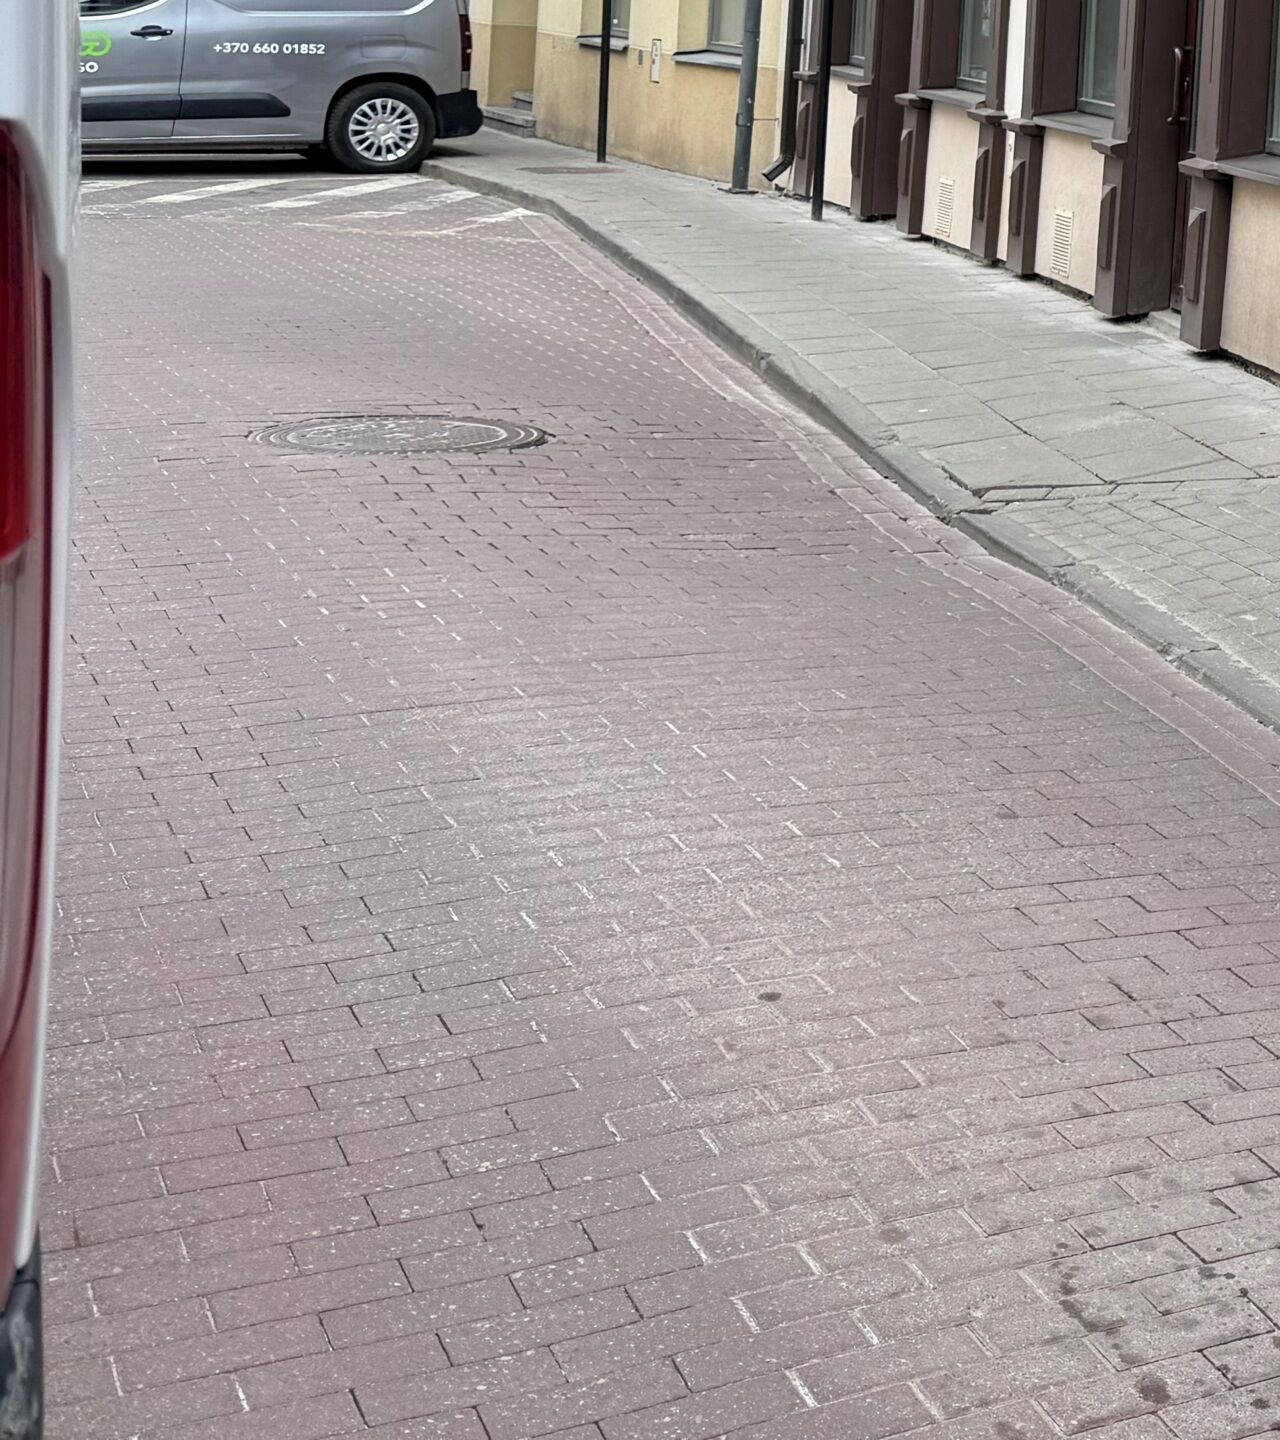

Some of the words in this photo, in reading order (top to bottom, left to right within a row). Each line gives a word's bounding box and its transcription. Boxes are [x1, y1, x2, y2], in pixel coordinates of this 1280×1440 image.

[213, 42, 249, 54] +370
[252, 42, 280, 54] 660
[283, 43, 326, 55] 01852
